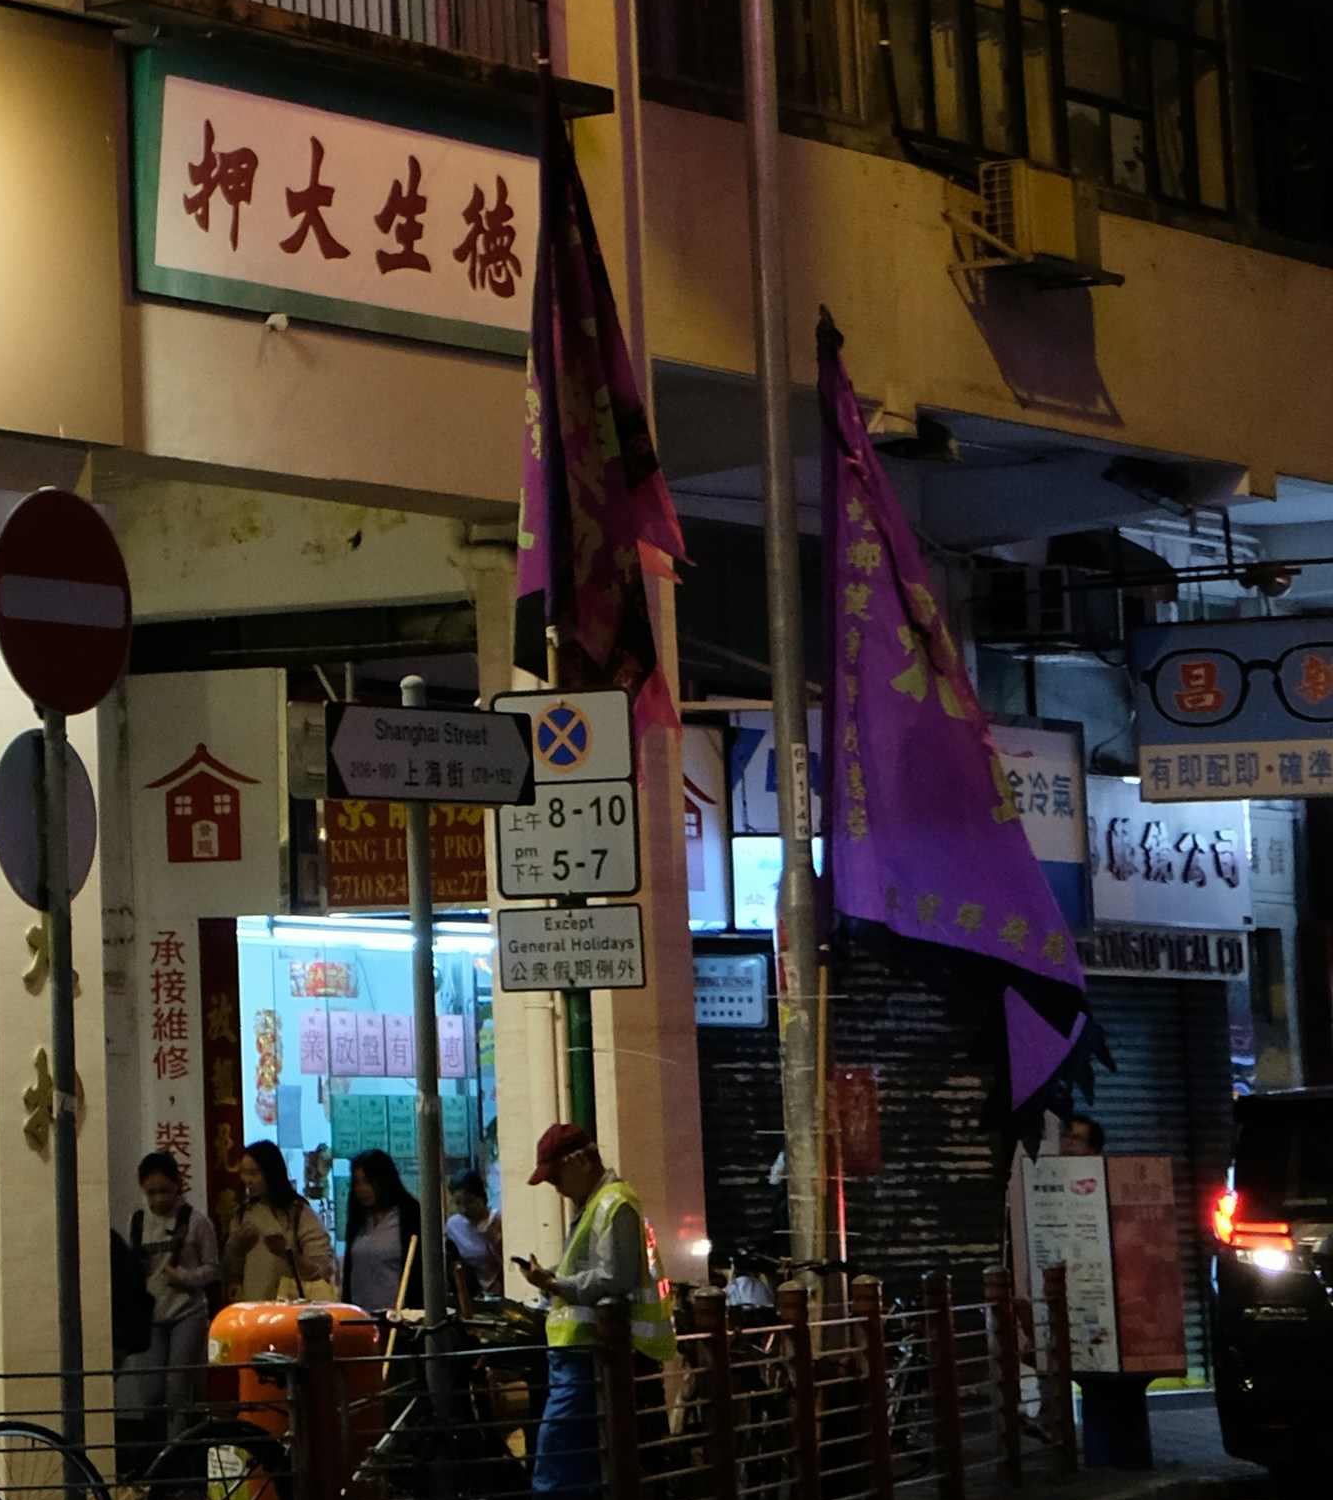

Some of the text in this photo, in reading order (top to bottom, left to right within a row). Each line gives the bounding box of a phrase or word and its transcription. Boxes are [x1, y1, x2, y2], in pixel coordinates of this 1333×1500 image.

[375, 718, 487, 746] Shanghai Street
[405, 758, 463, 788] 上海街
[508, 812, 541, 832] 上午
[330, 838, 377, 863] KING
[515, 847, 538, 861] pm
[511, 864, 544, 883] 下午
[544, 917, 594, 932] Except
[508, 938, 635, 953] General Holidays
